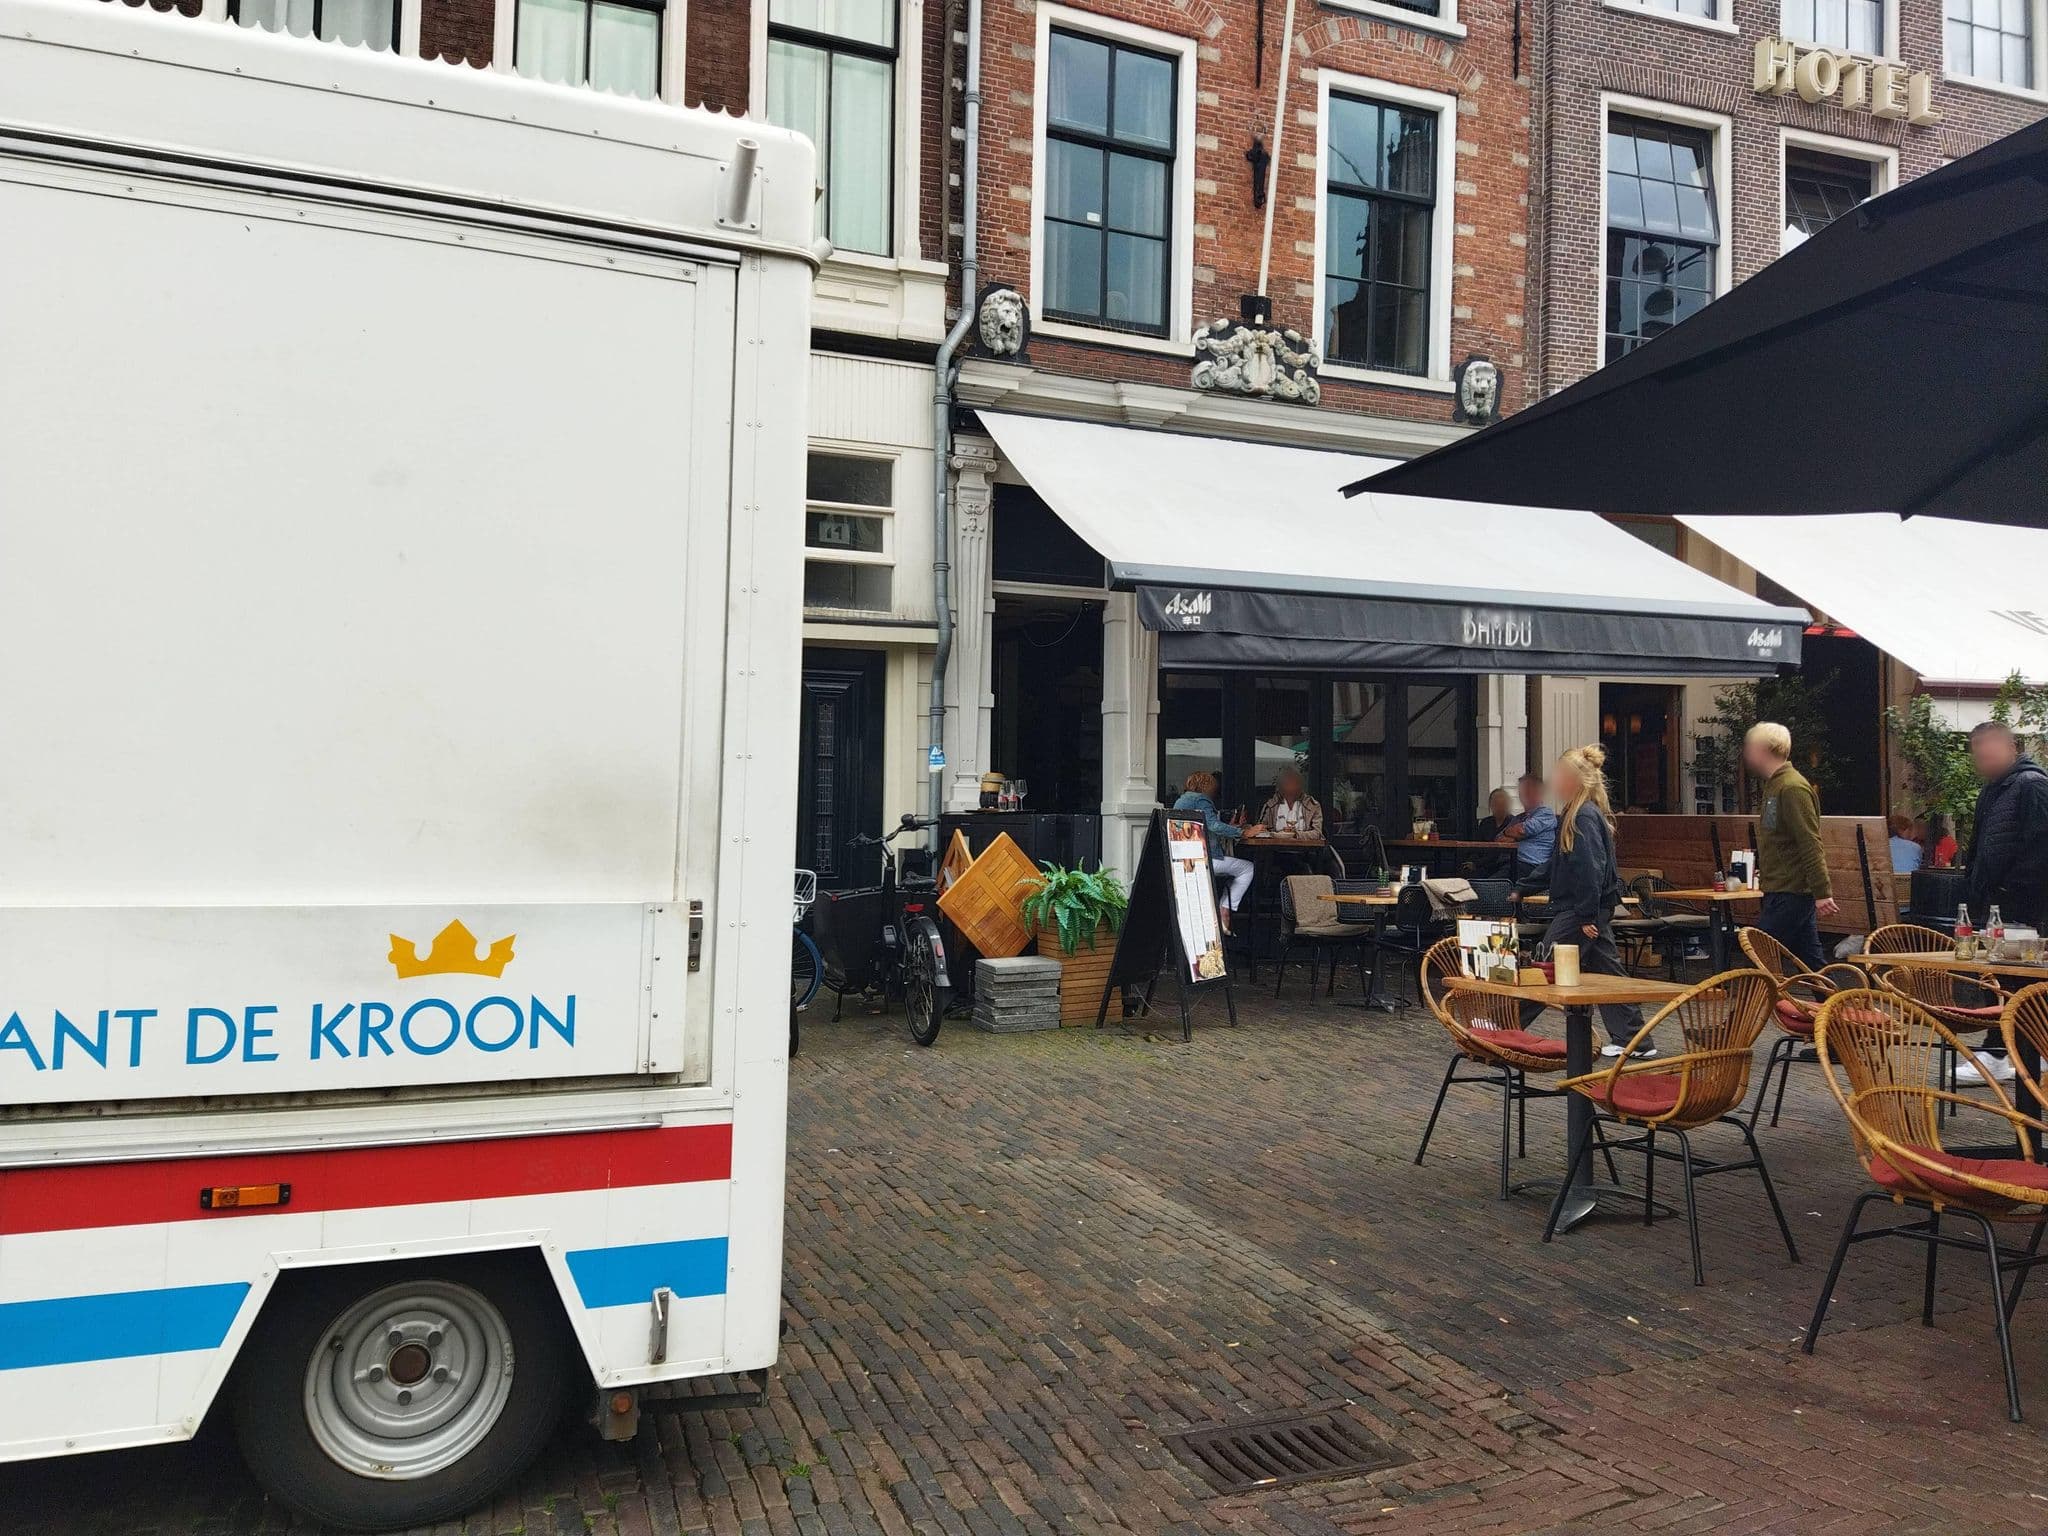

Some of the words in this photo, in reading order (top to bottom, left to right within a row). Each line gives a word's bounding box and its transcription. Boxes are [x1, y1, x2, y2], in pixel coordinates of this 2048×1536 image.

[1754, 36, 1943, 125] HOTEL
[1165, 591, 1212, 615] Asahi
[0, 1008, 158, 1071] ANT
[186, 1005, 279, 1064] DE
[310, 994, 576, 1060] KROON
